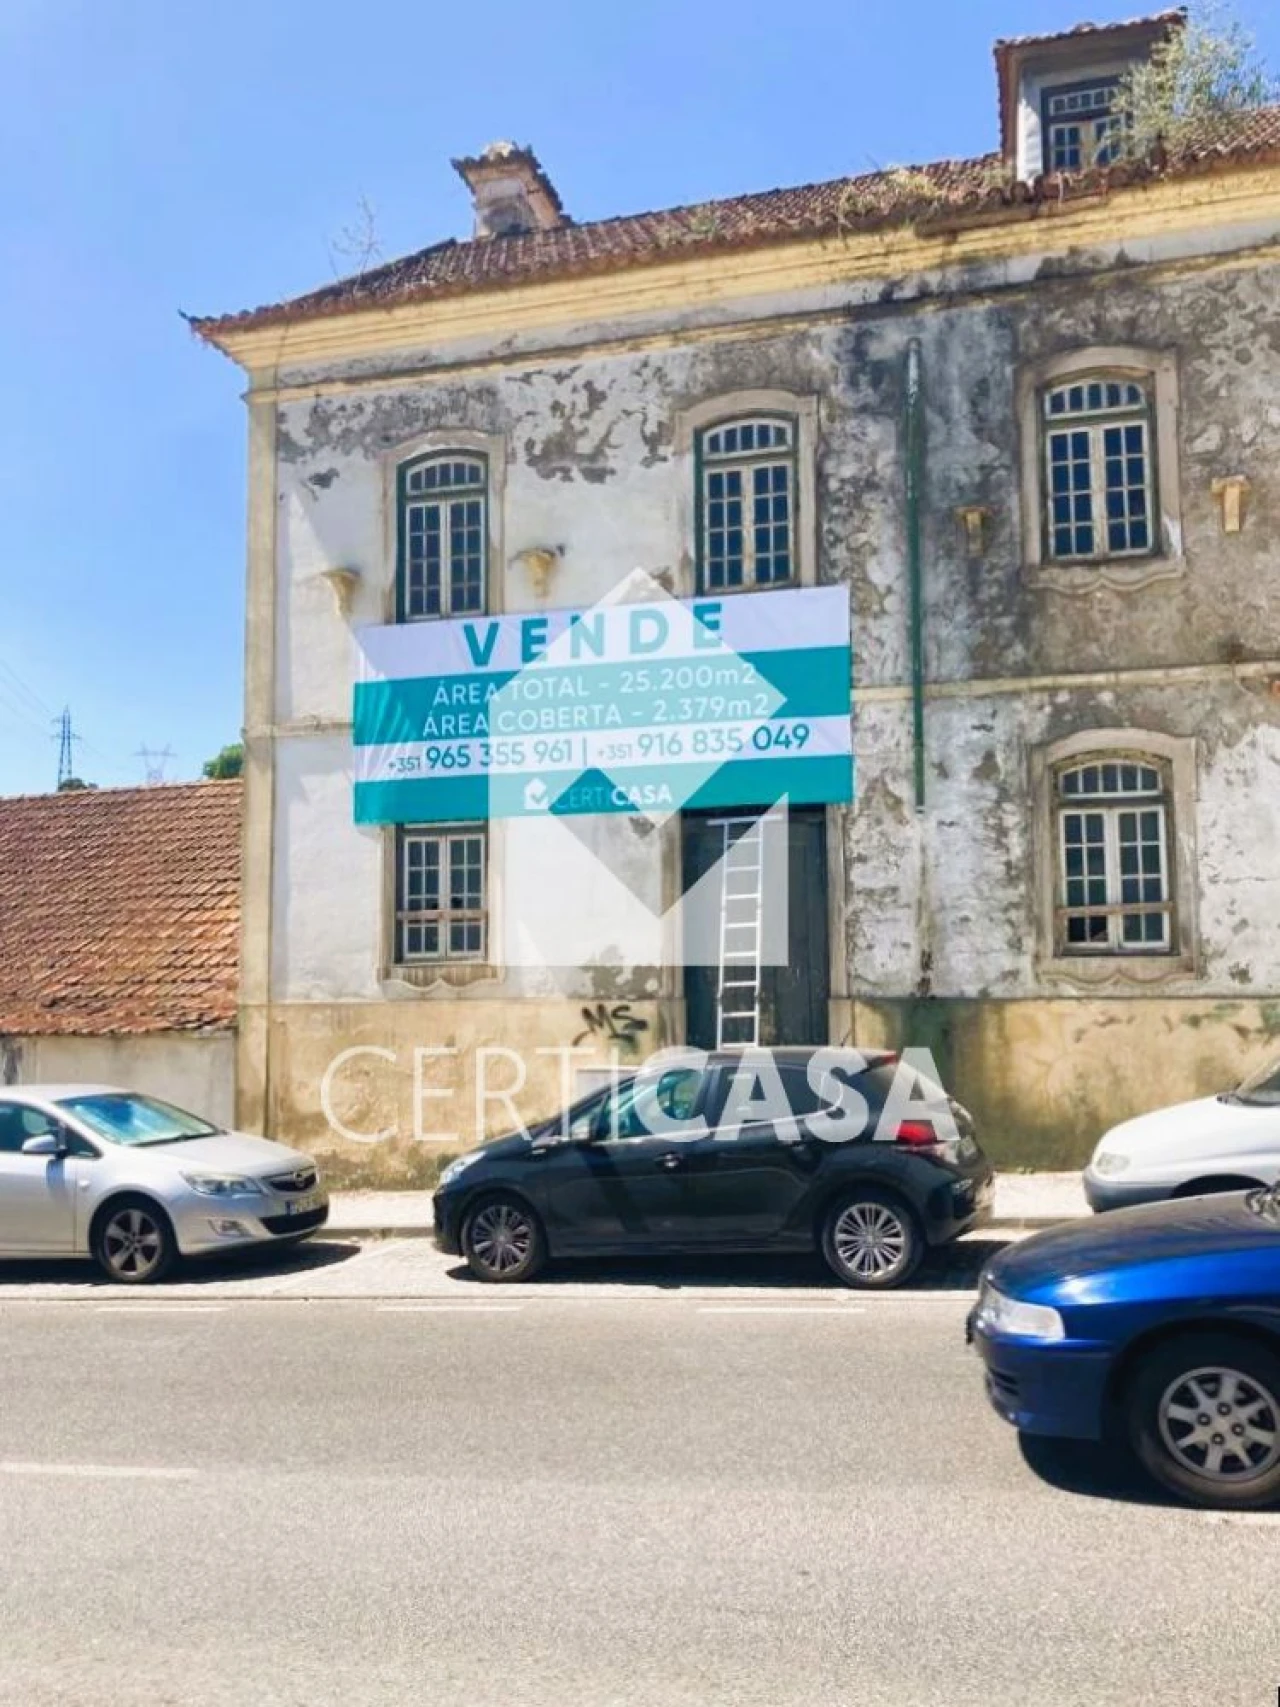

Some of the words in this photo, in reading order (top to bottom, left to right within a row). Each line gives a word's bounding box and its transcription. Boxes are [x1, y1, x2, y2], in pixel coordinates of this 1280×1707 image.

[463, 602, 722, 667] VENDE
[433, 680, 500, 708] ÁREA
[511, 676, 590, 701] TOTAL
[620, 663, 755, 693] 25.200m2
[423, 710, 489, 738] ÁREA
[497, 704, 622, 732] COBERTA
[652, 694, 769, 721] 2.379m2
[388, 757, 421, 772] +351
[426, 745, 471, 768] 965
[480, 741, 526, 766] 355
[534, 738, 573, 763] 961
[597, 744, 632, 760] +351
[638, 732, 683, 756] 916
[692, 726, 744, 753] 835
[752, 723, 810, 750] 049
